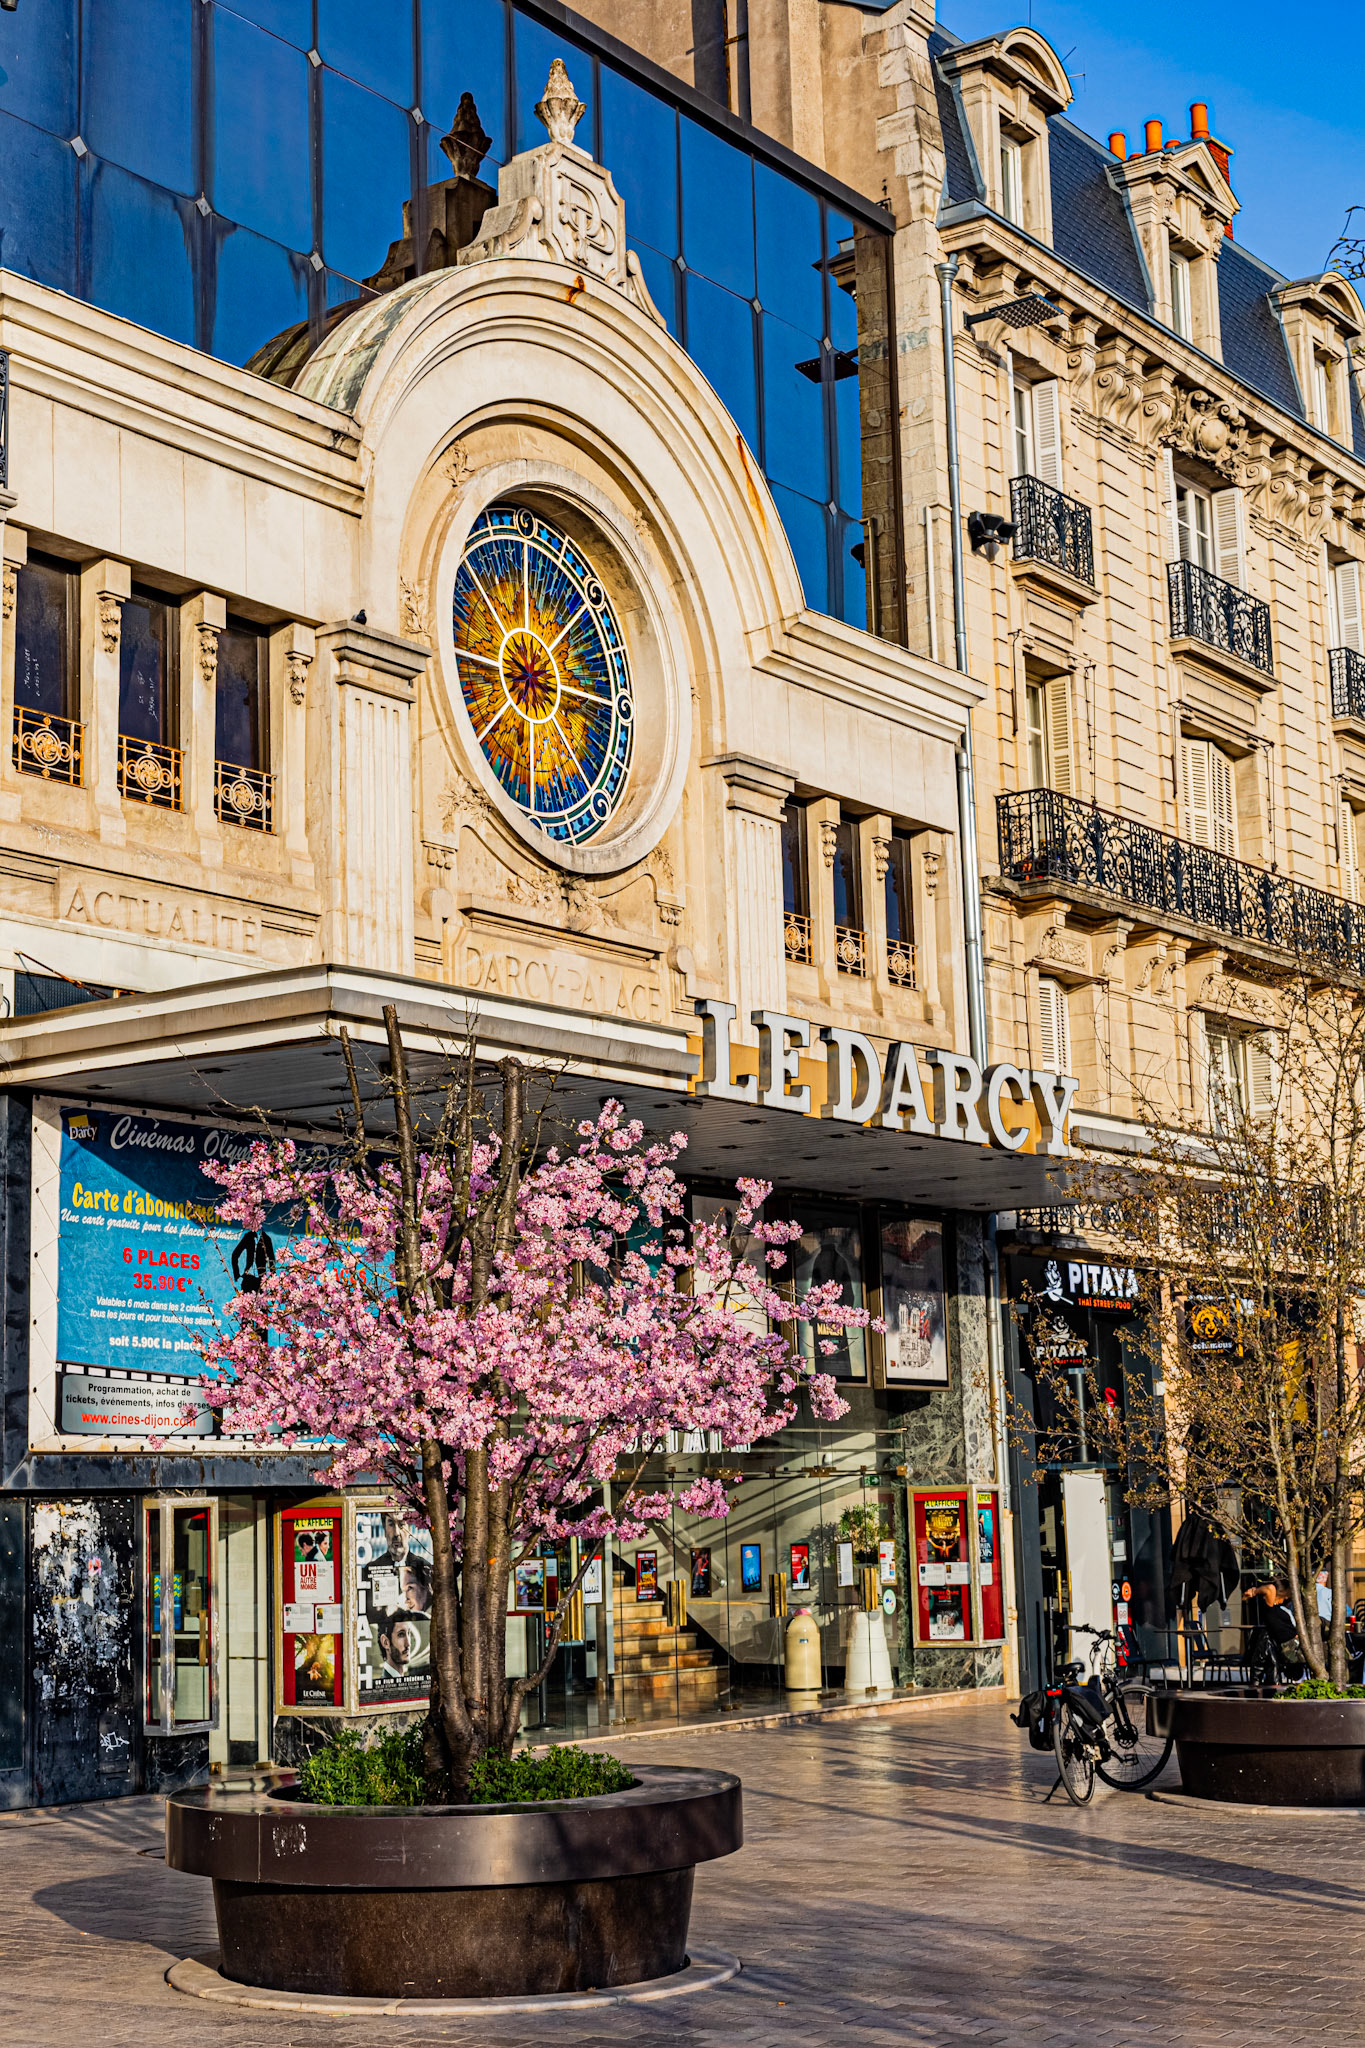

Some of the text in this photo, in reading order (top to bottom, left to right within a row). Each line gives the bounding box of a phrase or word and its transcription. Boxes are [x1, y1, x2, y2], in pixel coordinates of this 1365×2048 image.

[65, 882, 257, 954] ACTUALITÉ
[466, 946, 663, 1023] DARCY-PALACE
[694, 999, 1079, 1157] LE DARCY
[69, 1126, 97, 1141] Darcy
[110, 1116, 196, 1153] Cinémas
[72, 1182, 232, 1225] Carte d'abonnemen
[61, 1208, 80, 1223] Une
[82, 1213, 104, 1226] carte
[106, 1216, 140, 1230] gratuite
[142, 1221, 162, 1234] pour
[163, 1221, 178, 1234] des
[179, 1223, 205, 1239] places
[122, 1247, 200, 1270] 6 PLACES
[1068, 1262, 1140, 1298] PITAYA
[96, 1296, 127, 1308] Valables
[127, 1298, 133, 1308] 6
[133, 1300, 150, 1309] mois
[151, 1300, 168, 1311] dans
[169, 1302, 180, 1312] les
[180, 1302, 186, 1312] 2
[1078, 1297, 1131, 1310] THAÏ STREET FOOD
[90, 1308, 106, 1319] tous
[107, 1309, 118, 1320] les
[118, 1310, 137, 1321] jours
[137, 1311, 145, 1320] et
[145, 1313, 161, 1325] pour
[184, 1315, 194, 1325] les
[109, 1336, 130, 1347] soit
[132, 1336, 161, 1349] 5.90€
[162, 1339, 172, 1350] la
[88, 1383, 191, 1397] Programmation, achat de
[65, 1395, 98, 1407] tickets,
[100, 1397, 153, 1409] événements,
[155, 1399, 175, 1408] infos
[81, 1411, 196, 1429] www.cines-dijon.com
[300, 1563, 317, 1577] UN
[300, 1576, 317, 1584] AUTRE
[357, 1515, 373, 1690] GOLIATH
